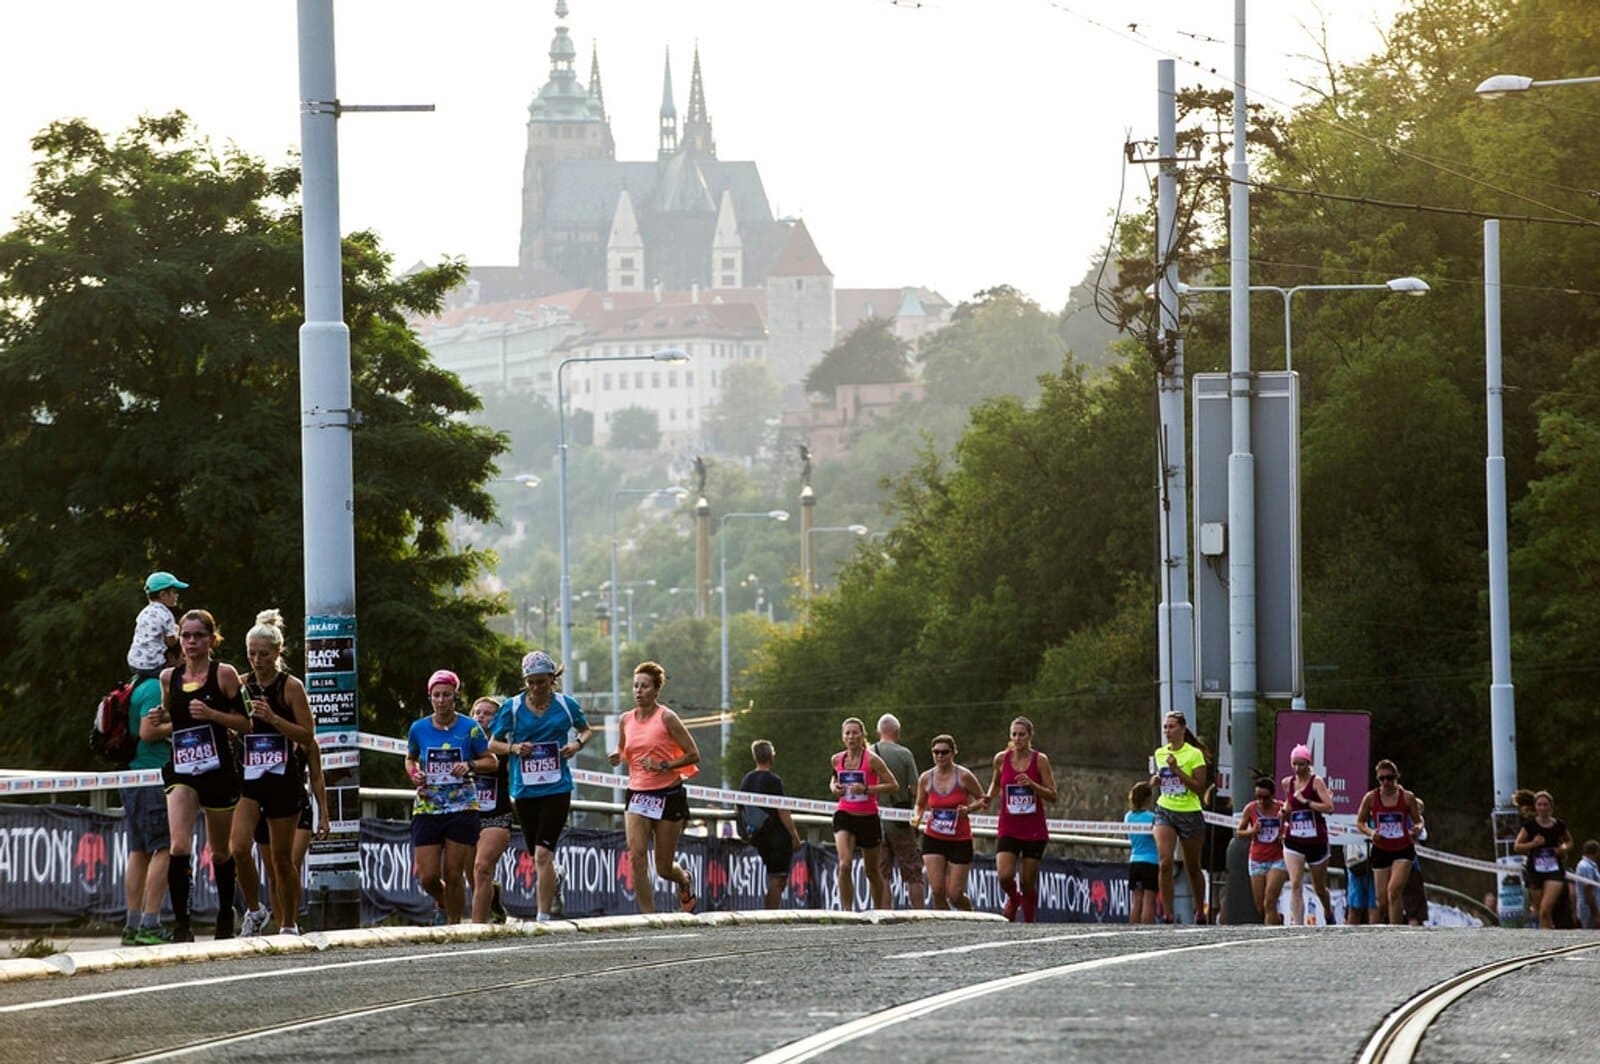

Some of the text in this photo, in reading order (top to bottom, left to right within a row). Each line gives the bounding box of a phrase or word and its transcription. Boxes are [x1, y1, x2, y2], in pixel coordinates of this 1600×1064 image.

[308, 693, 354, 703] TRAFAKT
[311, 703, 339, 713] KTOR
[176, 743, 213, 763] F5248
[1306, 723, 1326, 779] 4
[429, 762, 456, 774] F503
[523, 758, 557, 773] F6755
[1328, 776, 1345, 790] km
[0, 828, 72, 884] ATTONI
[1038, 871, 1090, 914] MATTONI
